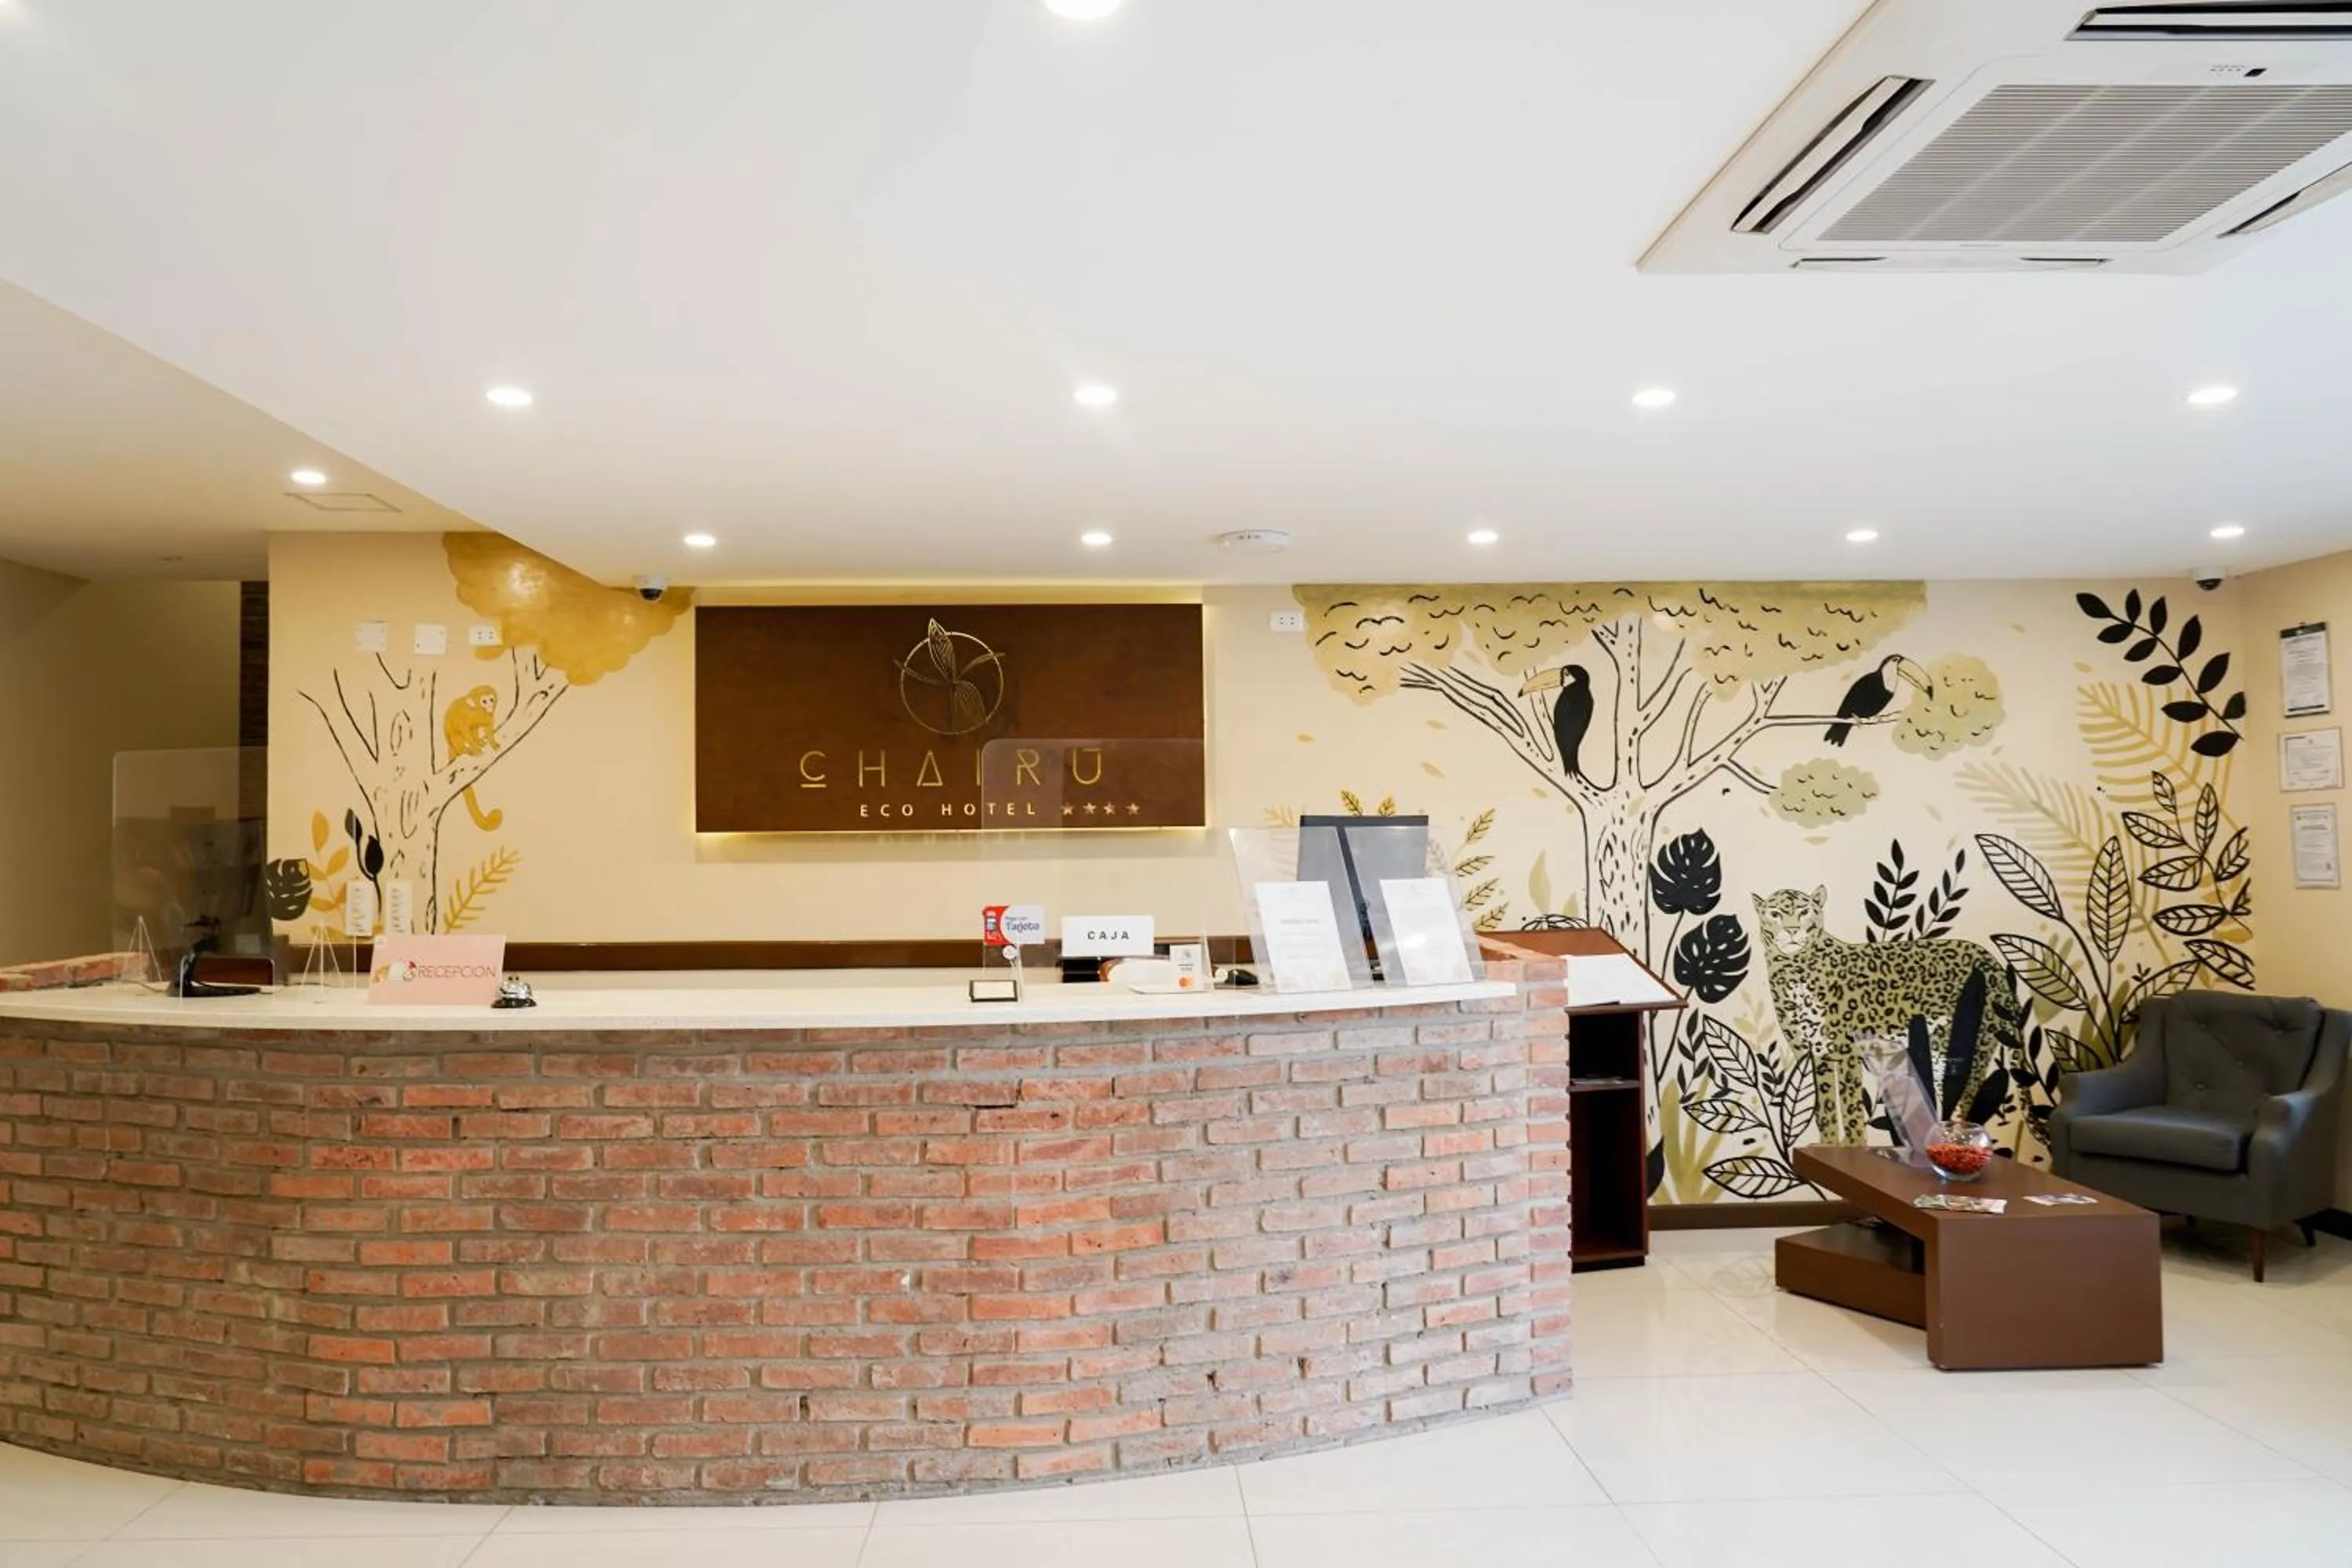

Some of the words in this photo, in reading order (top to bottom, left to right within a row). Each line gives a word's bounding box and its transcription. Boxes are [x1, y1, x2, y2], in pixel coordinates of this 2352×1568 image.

[859, 804, 913, 818] ECO
[942, 802, 1036, 817] HOTEL
[1087, 931, 1129, 940] CAJA
